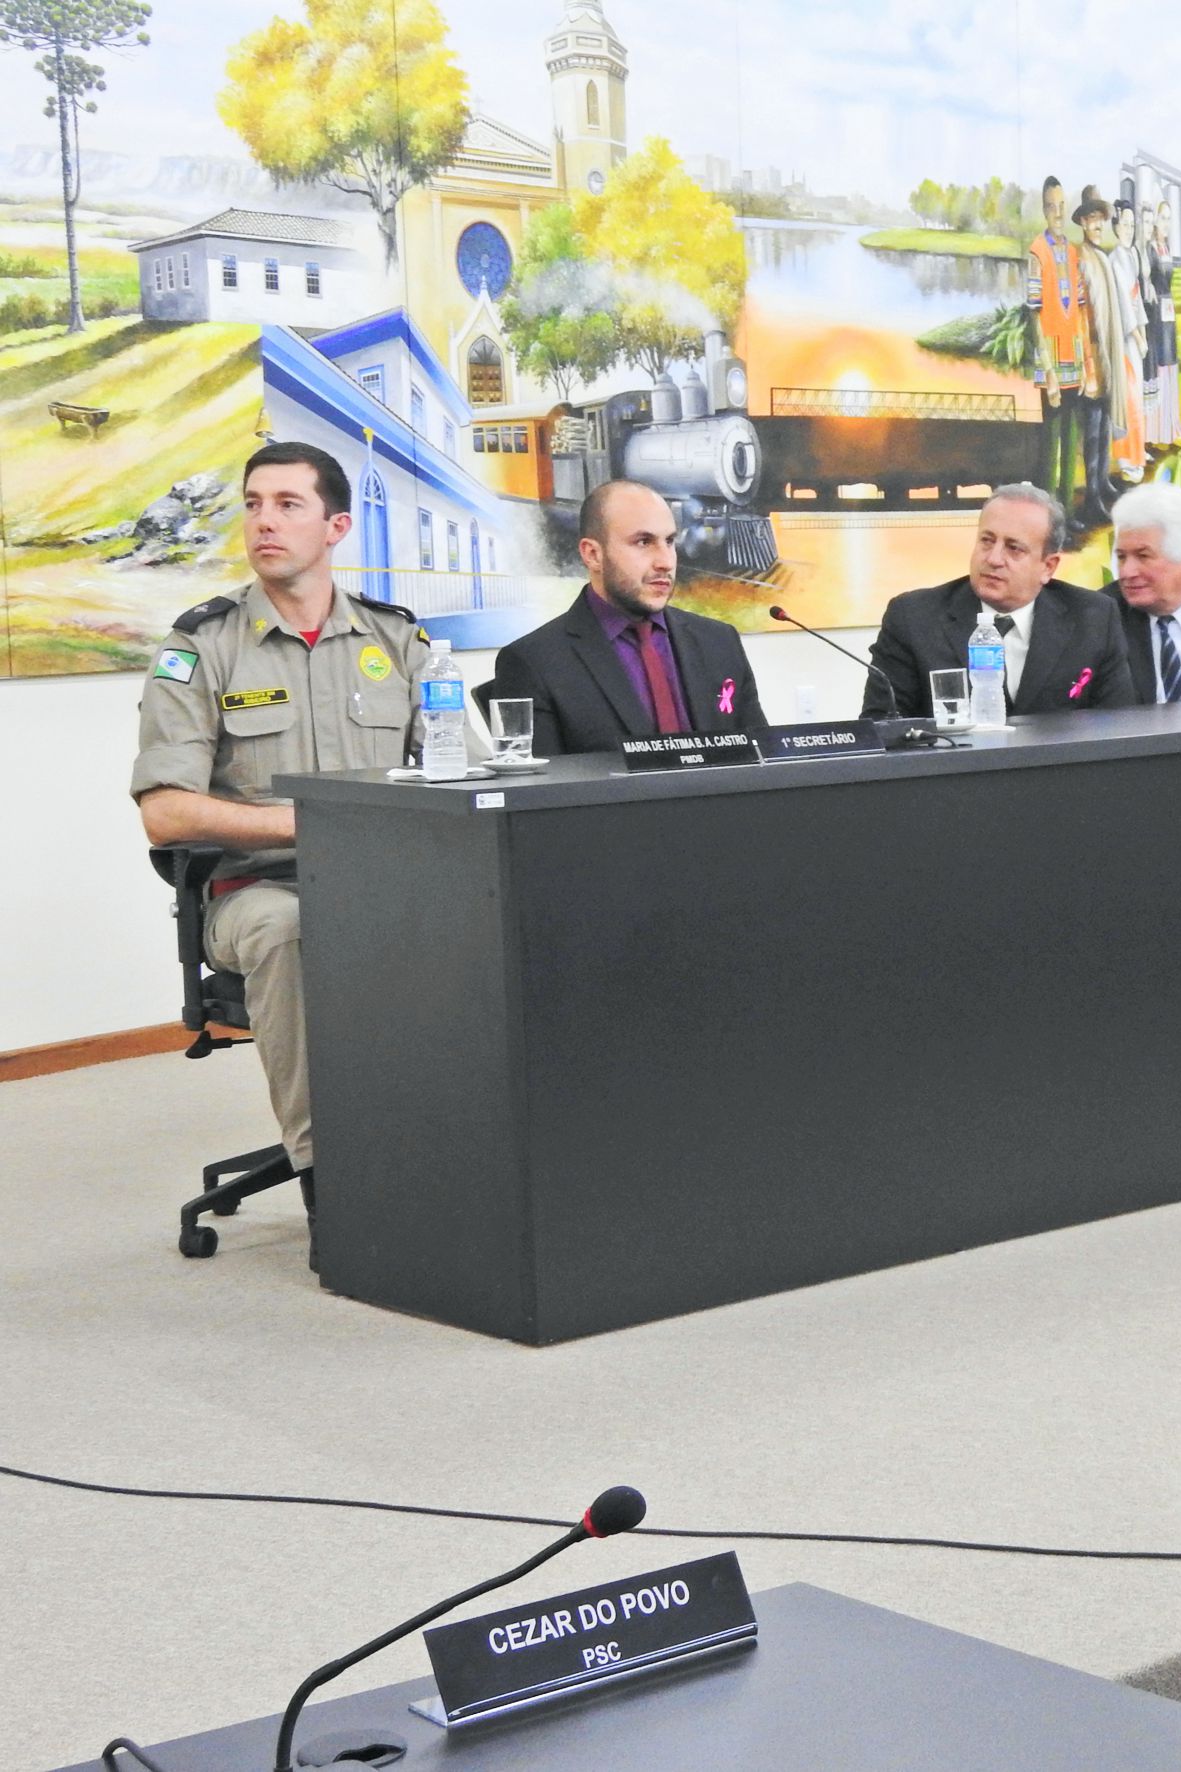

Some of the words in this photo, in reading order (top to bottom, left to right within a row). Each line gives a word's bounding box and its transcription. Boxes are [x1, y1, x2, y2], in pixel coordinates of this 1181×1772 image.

[623, 741, 653, 753] MARIA
[651, 740, 666, 752] DE
[664, 737, 696, 751] FÁTIMA
[694, 737, 705, 748] B.
[705, 737, 715, 748] A.
[713, 734, 748, 747] CASTRO
[792, 731, 856, 748] SECRETÁRIO
[488, 1609, 576, 1655] CEZAR
[578, 1598, 617, 1631] DO
[620, 1579, 690, 1619] POVO
[582, 1641, 622, 1668] PSC
